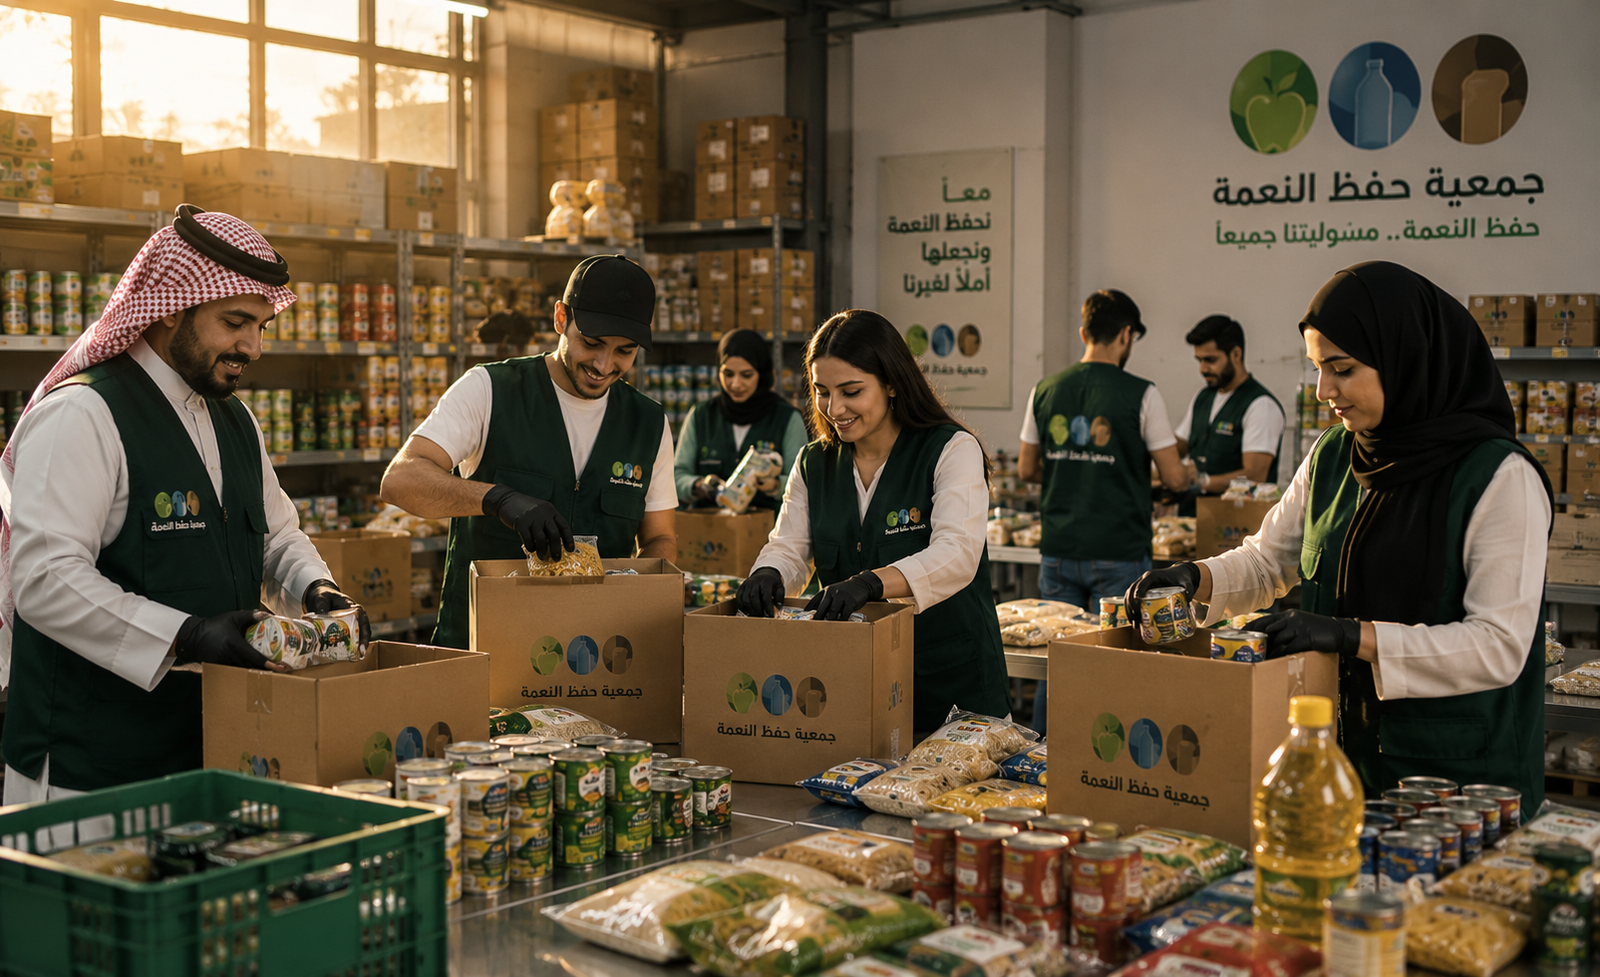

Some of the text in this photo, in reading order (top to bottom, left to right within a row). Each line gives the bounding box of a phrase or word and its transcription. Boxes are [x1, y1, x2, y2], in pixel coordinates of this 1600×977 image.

[1212, 167, 1545, 207] جمعية حفظ النعمة
[886, 212, 991, 234] نحفظ النعمة
[1483, 216, 1541, 238] حفظ
[921, 241, 991, 266] ونجعلها
[520, 684, 643, 700] جمعية حفظ النعمة
[716, 722, 836, 745] جمعية حفظ النعمة
[1080, 770, 1210, 811] جمعية حفظ النعمة
